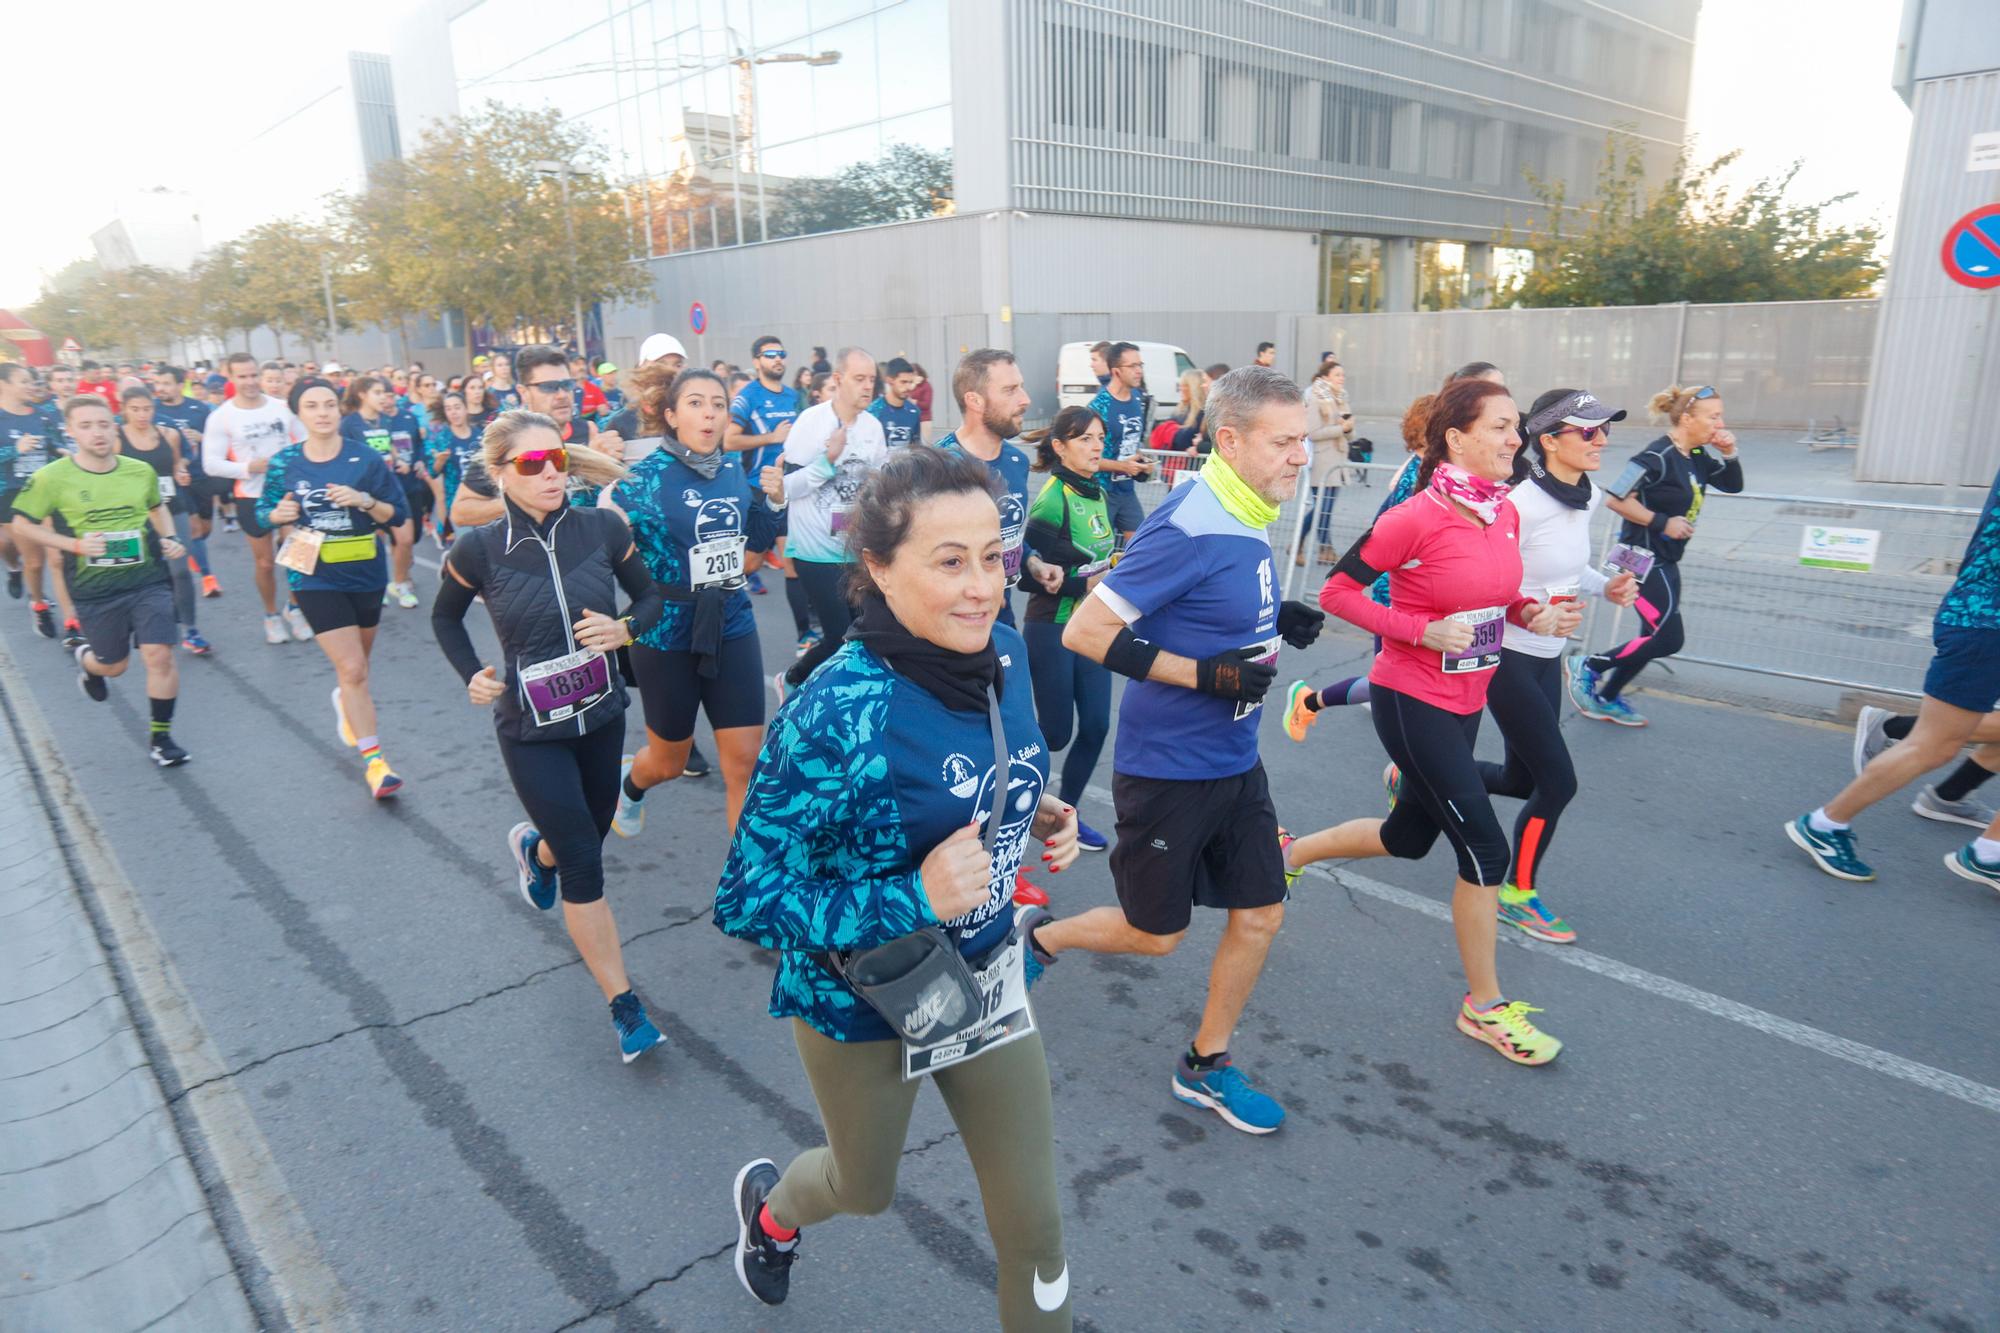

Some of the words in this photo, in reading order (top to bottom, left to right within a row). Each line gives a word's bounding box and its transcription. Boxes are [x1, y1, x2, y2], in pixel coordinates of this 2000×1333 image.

[706, 551, 739, 575] 2376
[1471, 622, 1496, 648] 559
[1017, 742, 1041, 761] Edició
[904, 990, 942, 1031] NIKE
